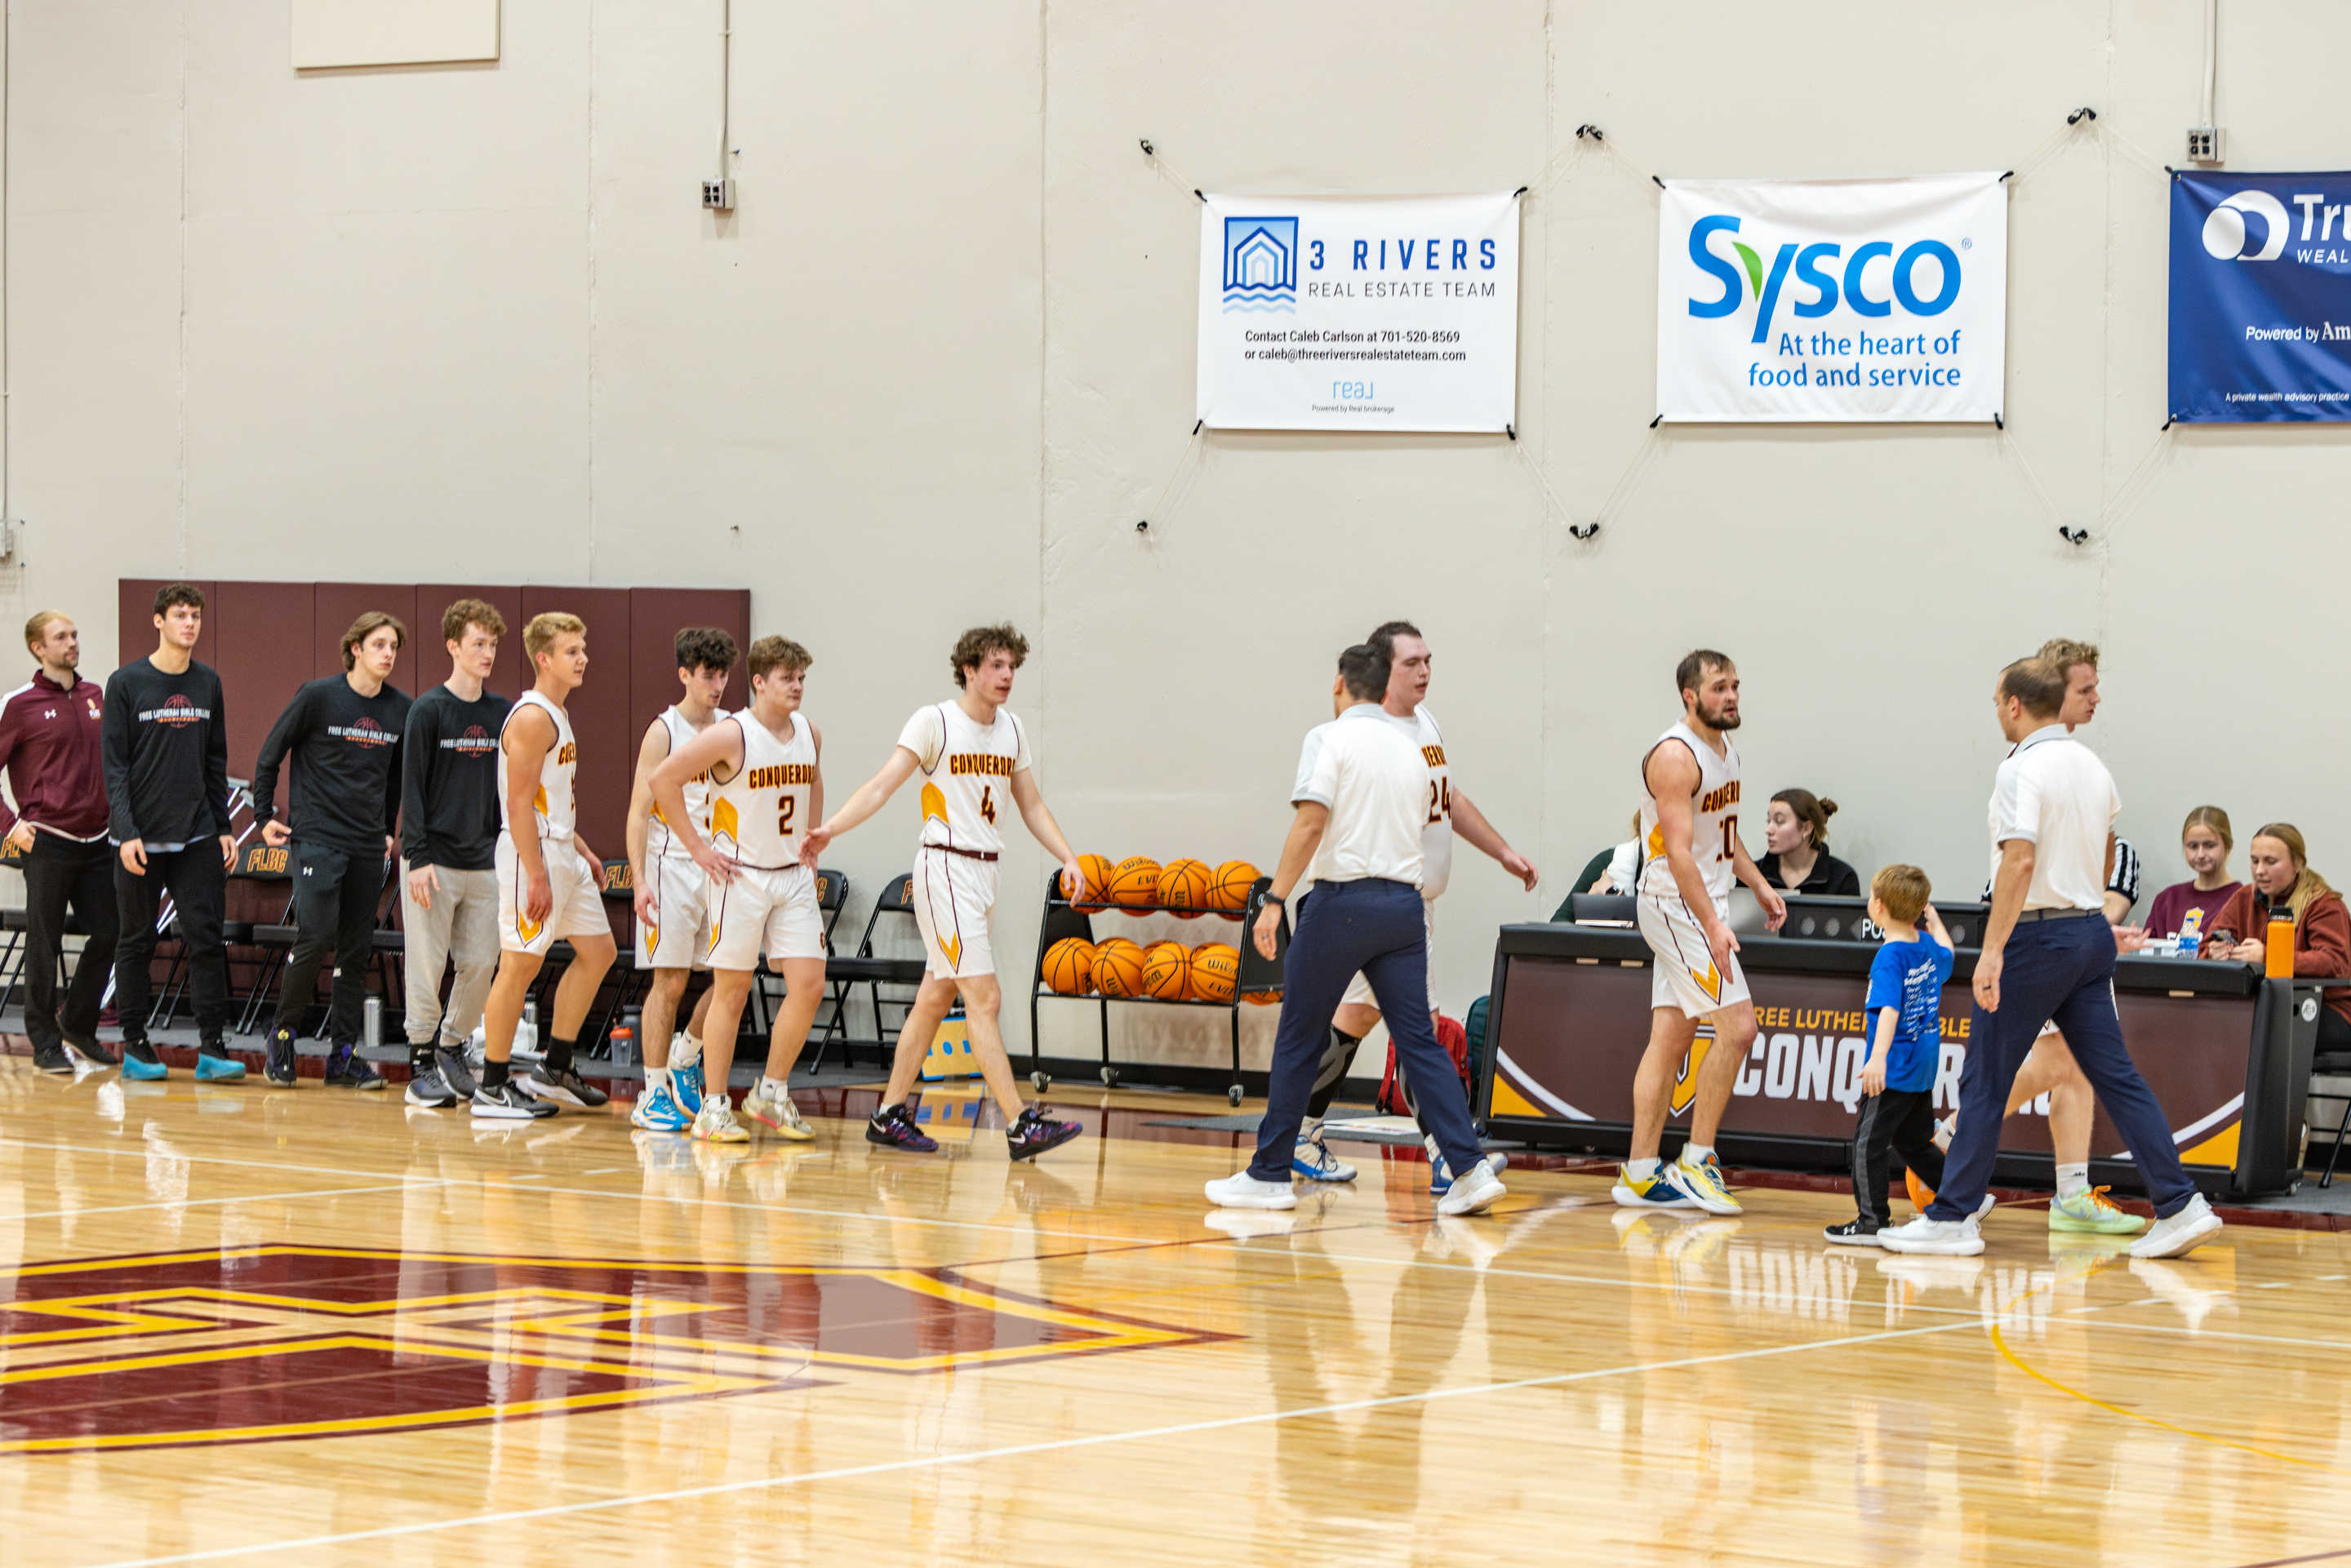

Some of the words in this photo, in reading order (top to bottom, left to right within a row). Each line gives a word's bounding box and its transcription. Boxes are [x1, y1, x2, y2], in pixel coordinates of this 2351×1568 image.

[1309, 240, 1325, 270] 3
[1353, 239, 1495, 270] RIVERS
[1309, 282, 1355, 298] REAL
[1365, 282, 1433, 298] ESTATE
[1442, 282, 1495, 297] TEAM
[1689, 215, 1961, 343] Sysco
[1245, 330, 1287, 343] Contact
[1290, 330, 1320, 343] Caleb
[1322, 330, 1364, 343] Carlson
[1367, 331, 1377, 343] at
[1380, 331, 1460, 343] 701-520-8569
[1779, 332, 1804, 356] At
[1811, 331, 1851, 355] the
[1860, 331, 1926, 355] heart
[1934, 330, 1961, 355] of
[2246, 326, 2301, 341] Powered
[2306, 326, 2319, 343] by
[1244, 349, 1256, 360] or
[1259, 349, 1467, 364] caleb@threeriversrealestateteam.com
[1749, 362, 1807, 387] food
[1816, 362, 1860, 386] and
[1869, 363, 1961, 387] service
[2232, 392, 2257, 404] private
[980, 784, 996, 826] 4
[1428, 775, 1451, 824] 24
[778, 794, 795, 836] 2
[247, 847, 289, 874] FLBC
